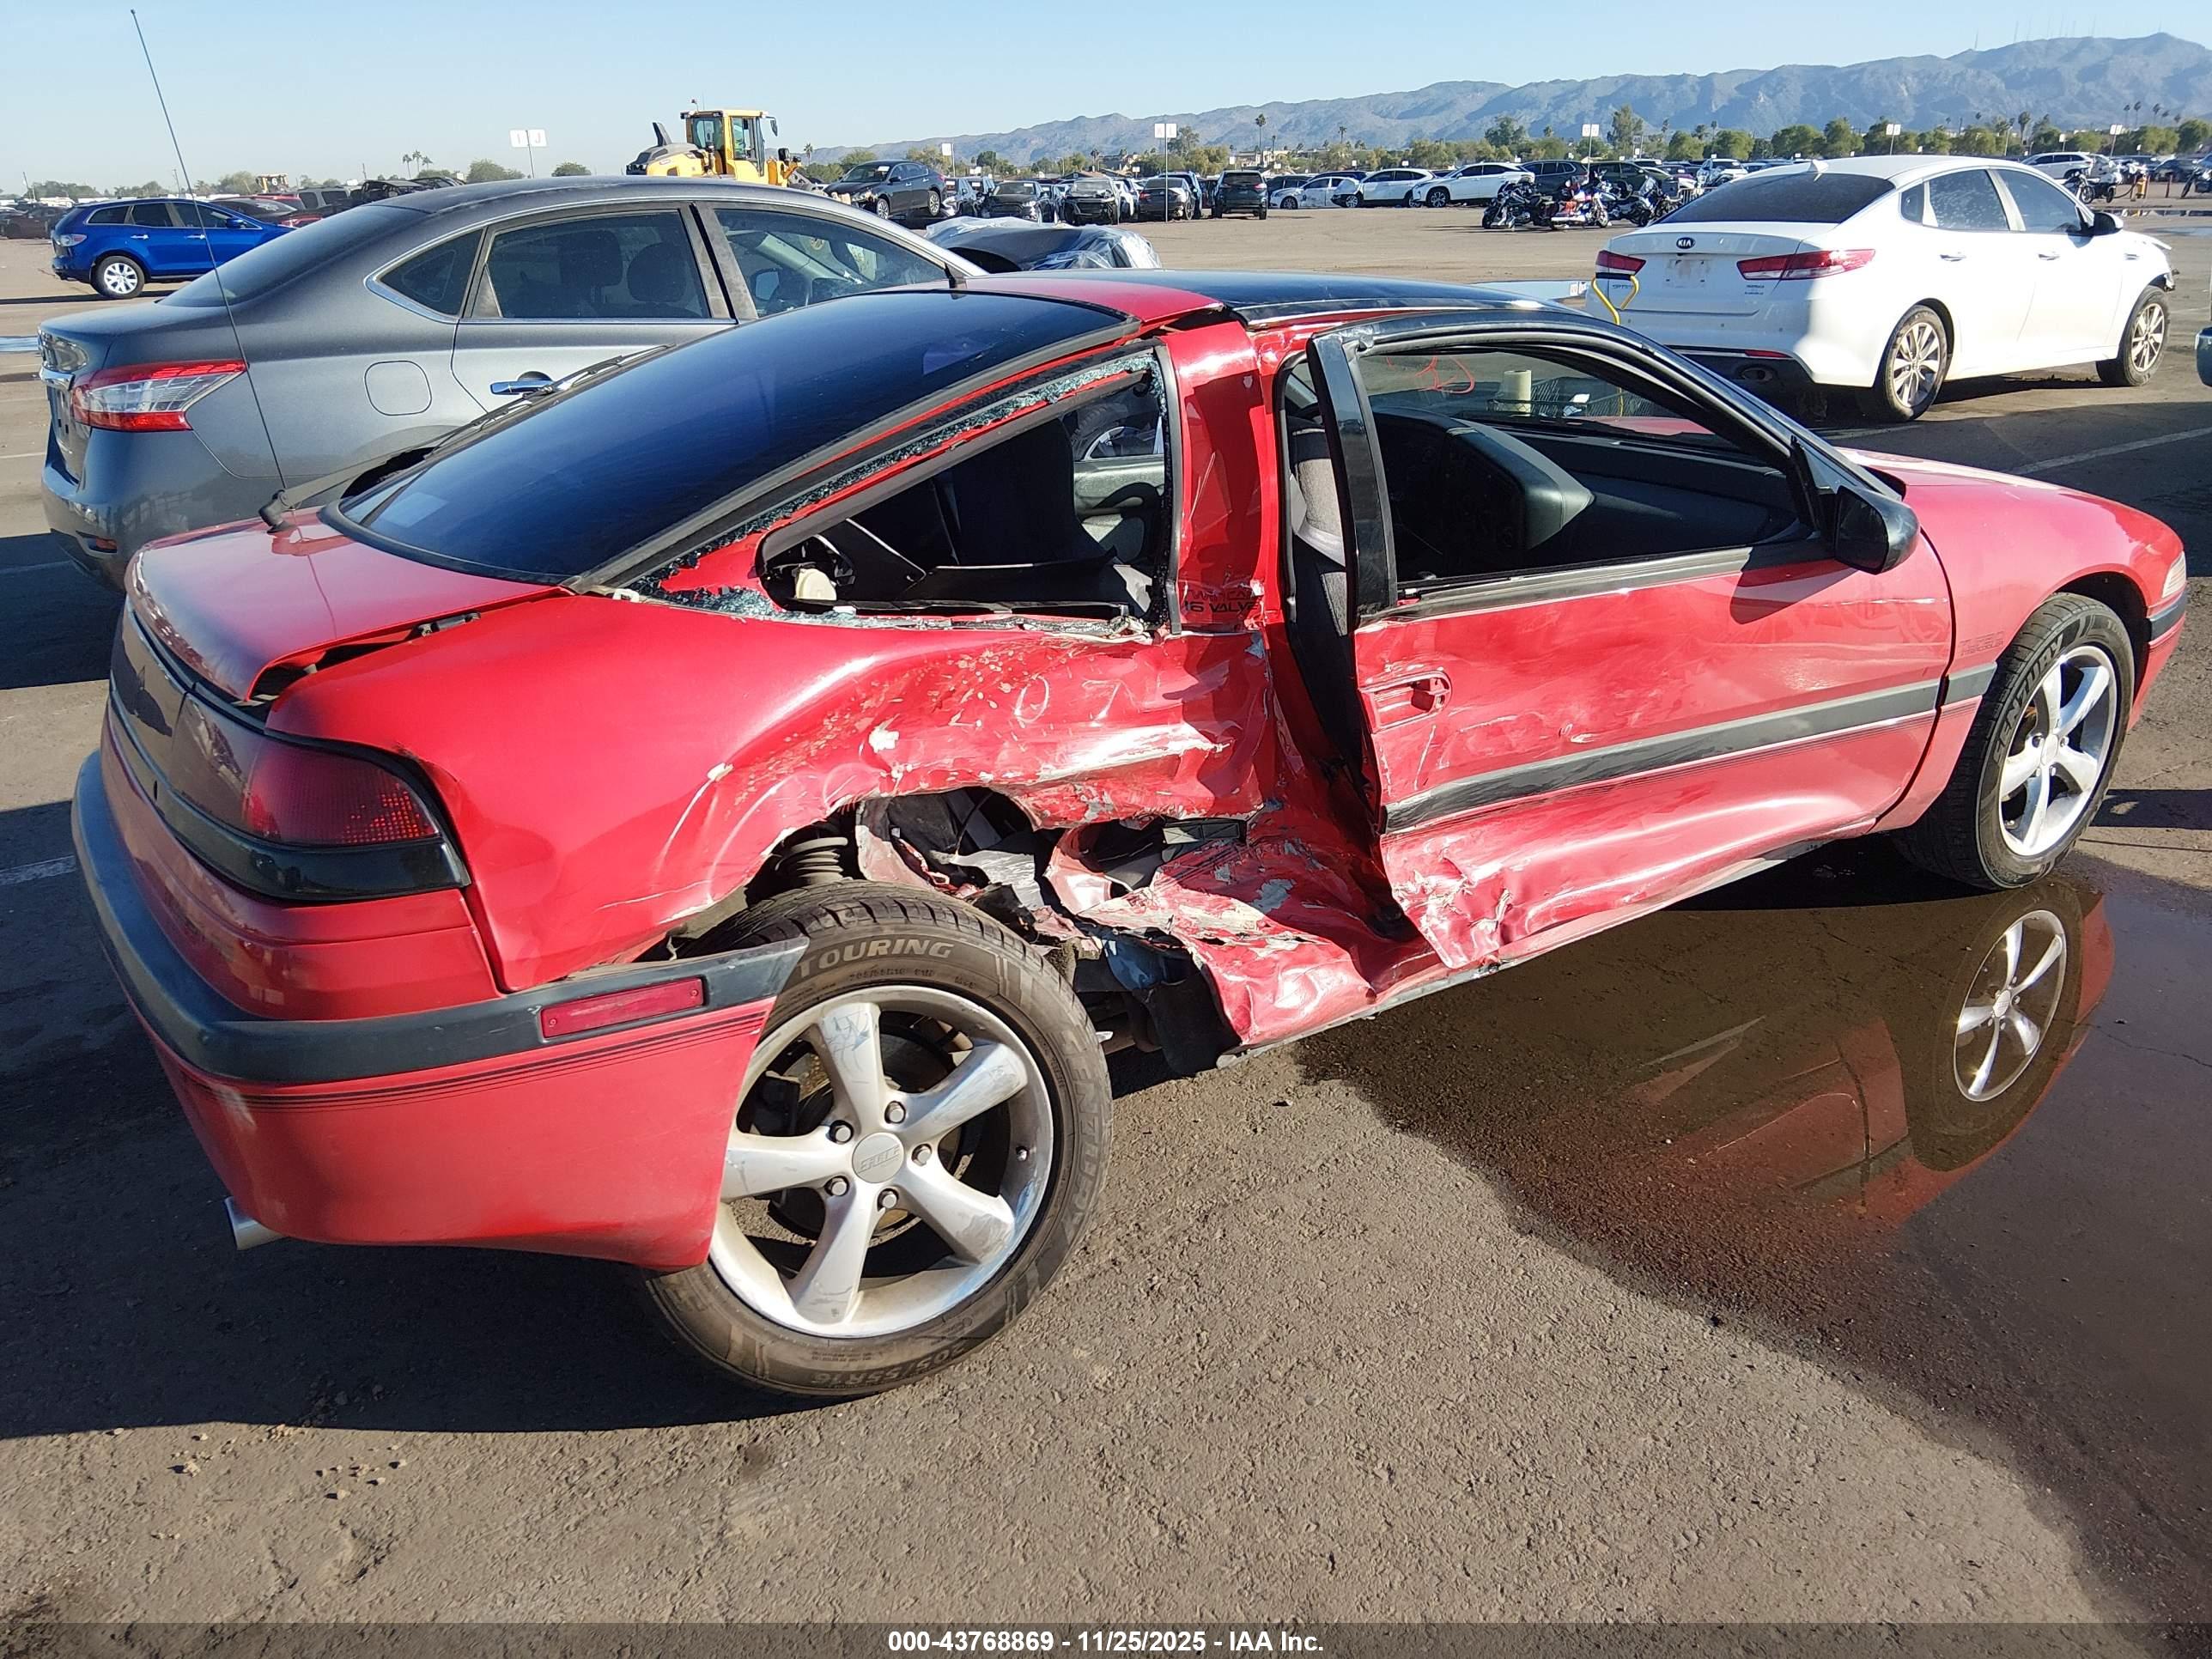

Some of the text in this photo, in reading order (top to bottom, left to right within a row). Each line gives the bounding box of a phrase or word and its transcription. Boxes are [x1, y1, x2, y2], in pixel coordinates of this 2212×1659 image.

[535, 132, 542, 144] J
[271, 177, 278, 186] 6
[1185, 601, 1255, 612] 16 VALVE
[797, 939, 955, 979] TOURING
